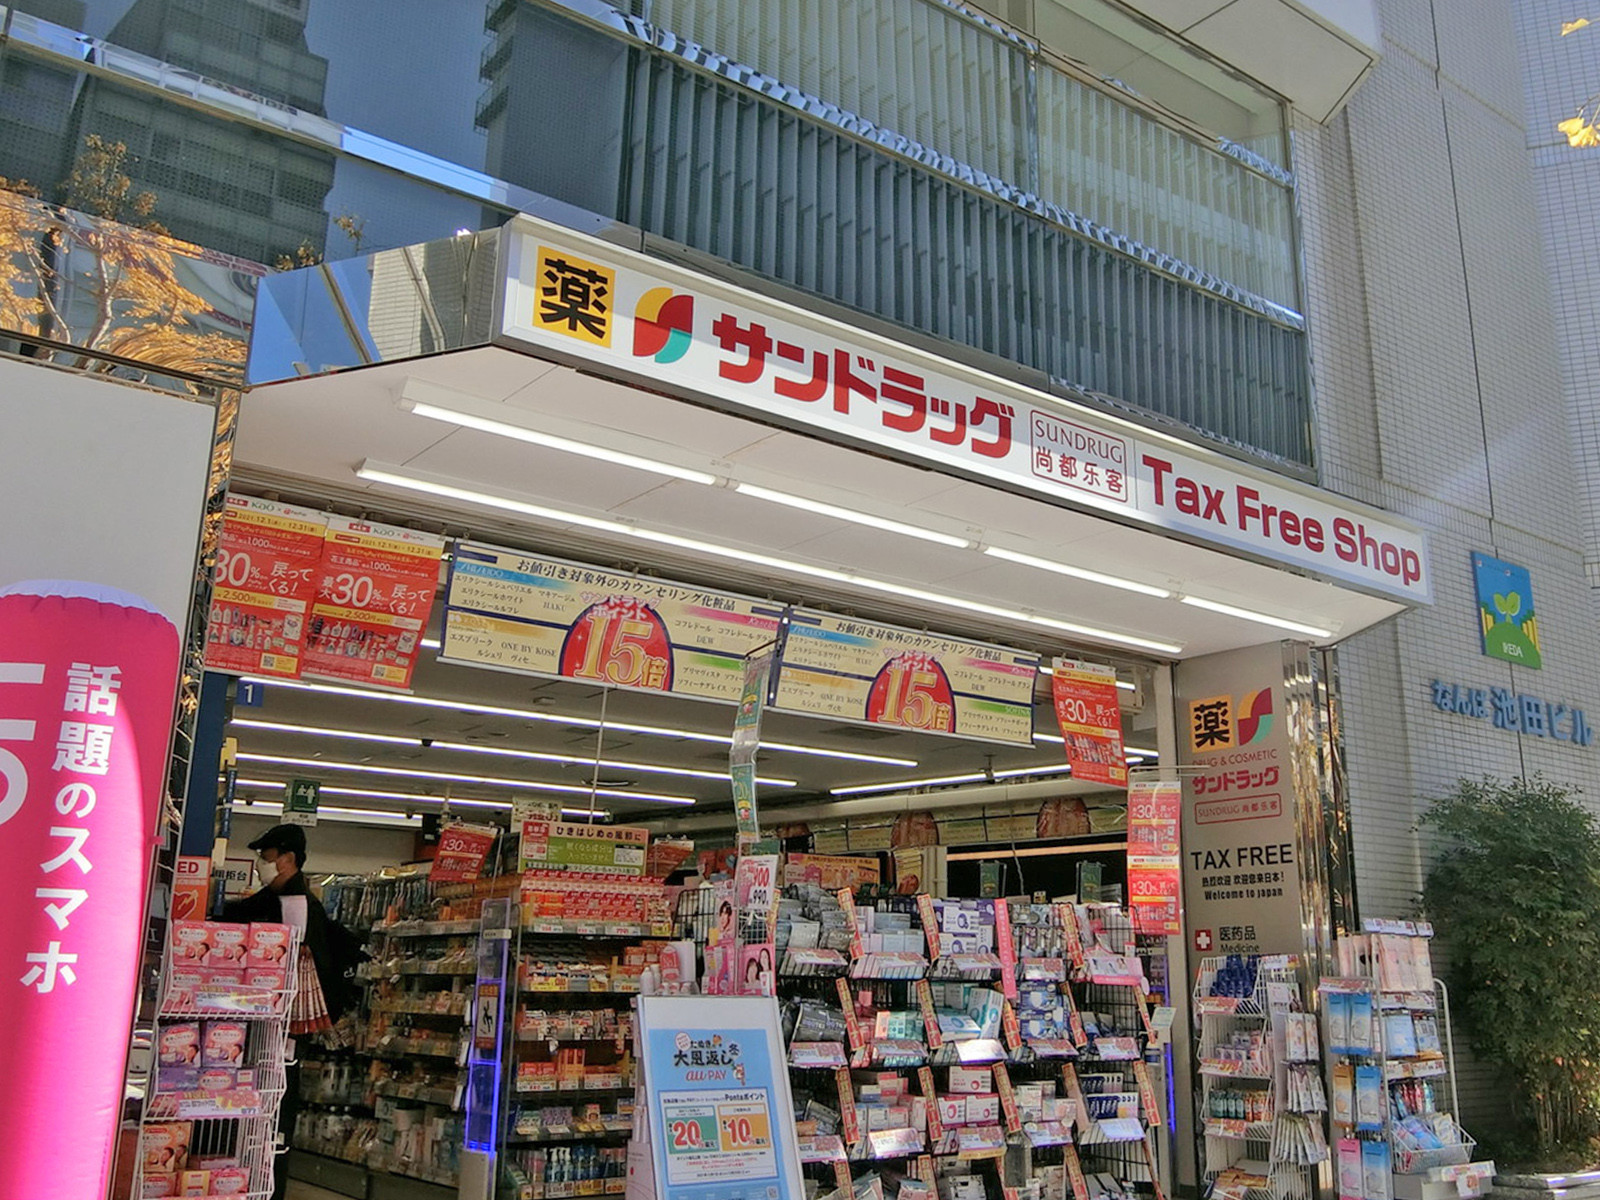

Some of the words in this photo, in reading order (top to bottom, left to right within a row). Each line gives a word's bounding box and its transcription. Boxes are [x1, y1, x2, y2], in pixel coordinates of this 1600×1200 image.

[539, 257, 609, 338] 薬
[712, 313, 1016, 459] サンドラッグ
[1035, 419, 1123, 464] SUNDRUG
[1036, 446, 1123, 494] 尚都乐客
[1142, 454, 1226, 525] Tax
[1236, 484, 1324, 553] Free
[1333, 517, 1421, 586] Shop
[271, 561, 314, 582] 戻って
[391, 583, 431, 602] 戻って
[517, 560, 736, 611] お値引き対象外のカウンセリング化粧品
[501, 641, 518, 652] ONE
[521, 644, 532, 653] BY
[836, 621, 1002, 662] お値引き対象外のカウンセリング化粧品
[244, 683, 255, 704] 1
[1430, 678, 1594, 746] なんば池田ビル
[1193, 700, 1231, 748] 薬
[1228, 748, 1278, 765] COSMETIC
[1192, 765, 1280, 795] サンドラッグ
[1198, 804, 1240, 818] SUNDRUG
[20, 662, 122, 994] 話題のスマホ
[556, 825, 642, 842] ひきはじめの風邪に
[1190, 848, 1232, 870] TAX
[1237, 843, 1294, 867] FREE
[177, 861, 199, 874] ED
[1205, 890, 1244, 900] Welcome
[1246, 889, 1256, 898] to
[1219, 925, 1257, 941] 医药品
[1220, 943, 1261, 953] Medicine
[673, 1049, 734, 1067] 大恩返し
[728, 1043, 740, 1056] 冬
[707, 1069, 727, 1081] PAY
